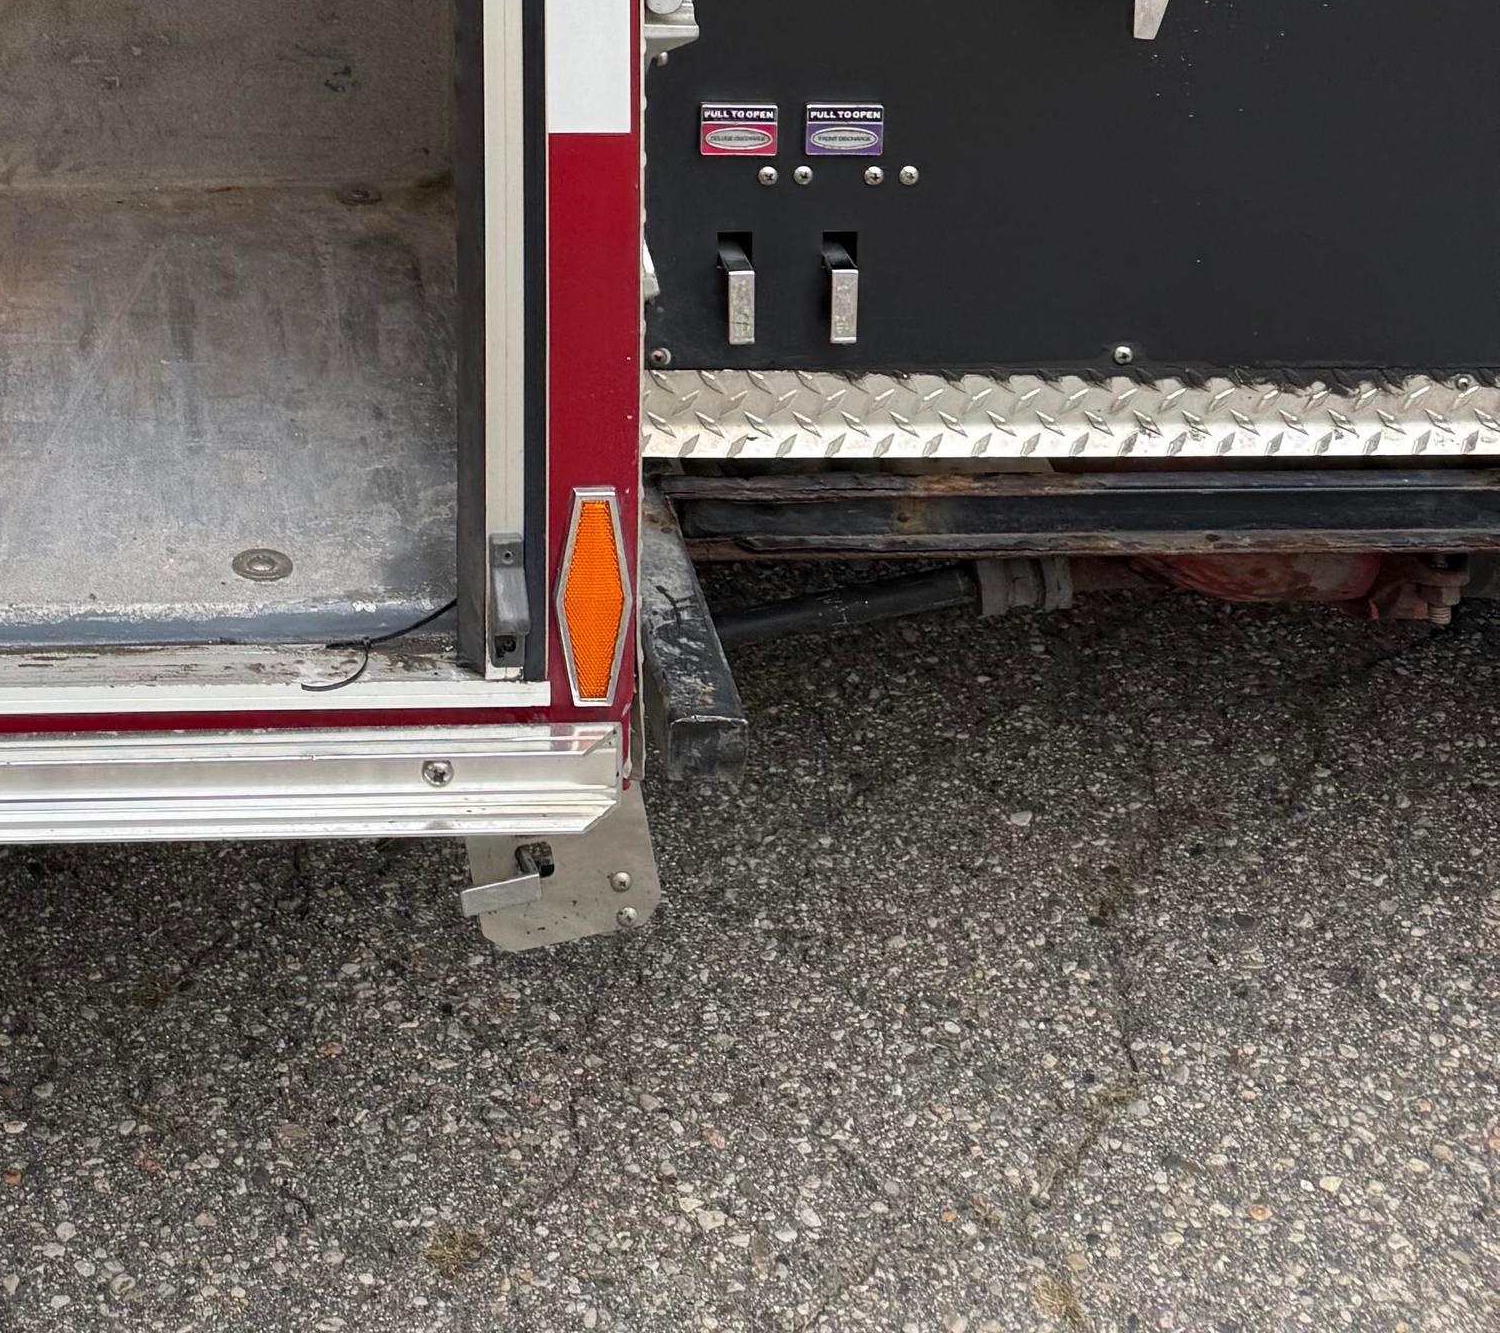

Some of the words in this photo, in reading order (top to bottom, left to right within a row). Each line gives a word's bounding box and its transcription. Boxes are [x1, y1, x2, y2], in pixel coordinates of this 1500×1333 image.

[704, 110, 729, 118] PULL
[731, 110, 745, 119] TO
[746, 111, 774, 119] OPEN
[810, 111, 836, 119] PULL
[838, 111, 852, 119] TO
[853, 111, 881, 119] OPEN
